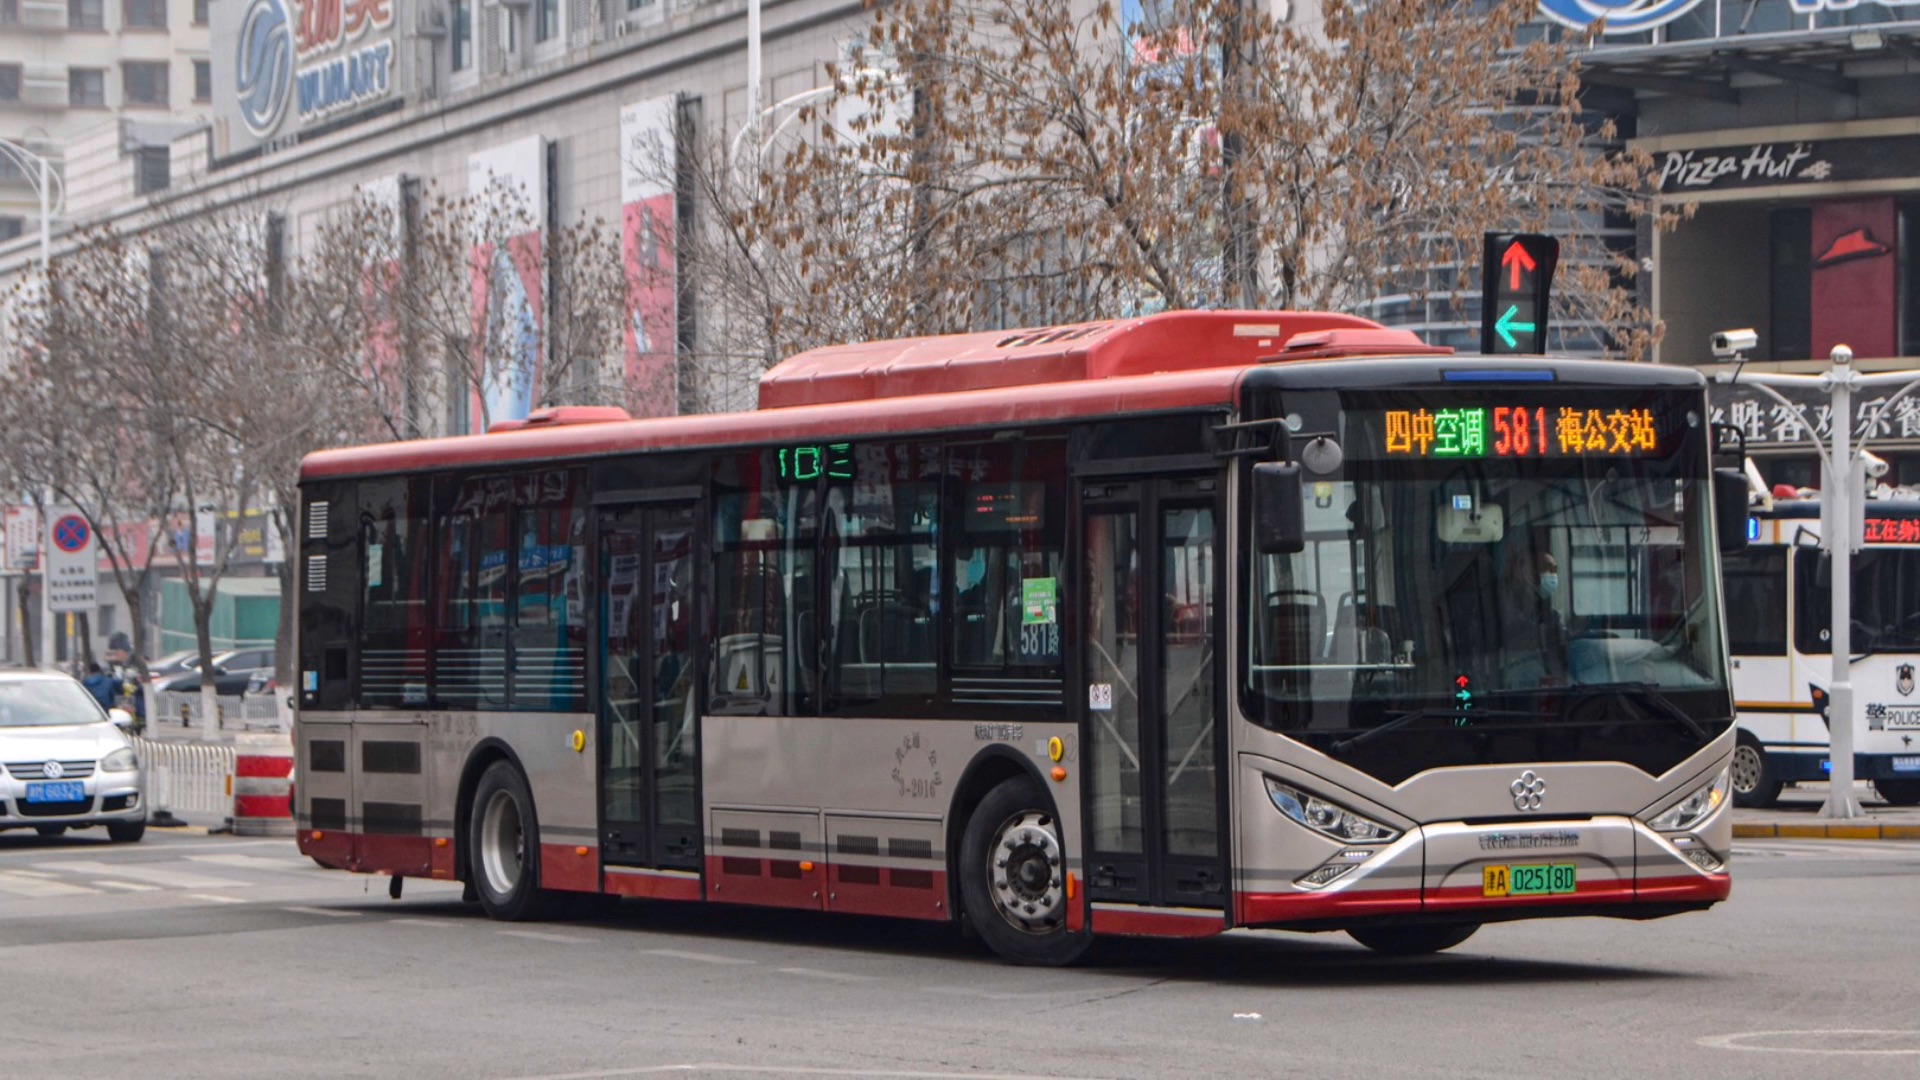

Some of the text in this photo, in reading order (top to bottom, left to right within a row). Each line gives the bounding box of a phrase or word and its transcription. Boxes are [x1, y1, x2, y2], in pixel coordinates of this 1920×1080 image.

[295, 40, 393, 119] WUMART
[1657, 144, 1811, 191] Pizza Hut
[1493, 406, 1547, 455] 581
[1556, 406, 1656, 454] 海公交站
[1020, 621, 1059, 656] 581路
[1866, 703, 1920, 731] 警 POLICE
[1513, 866, 1575, 891] 02518D
